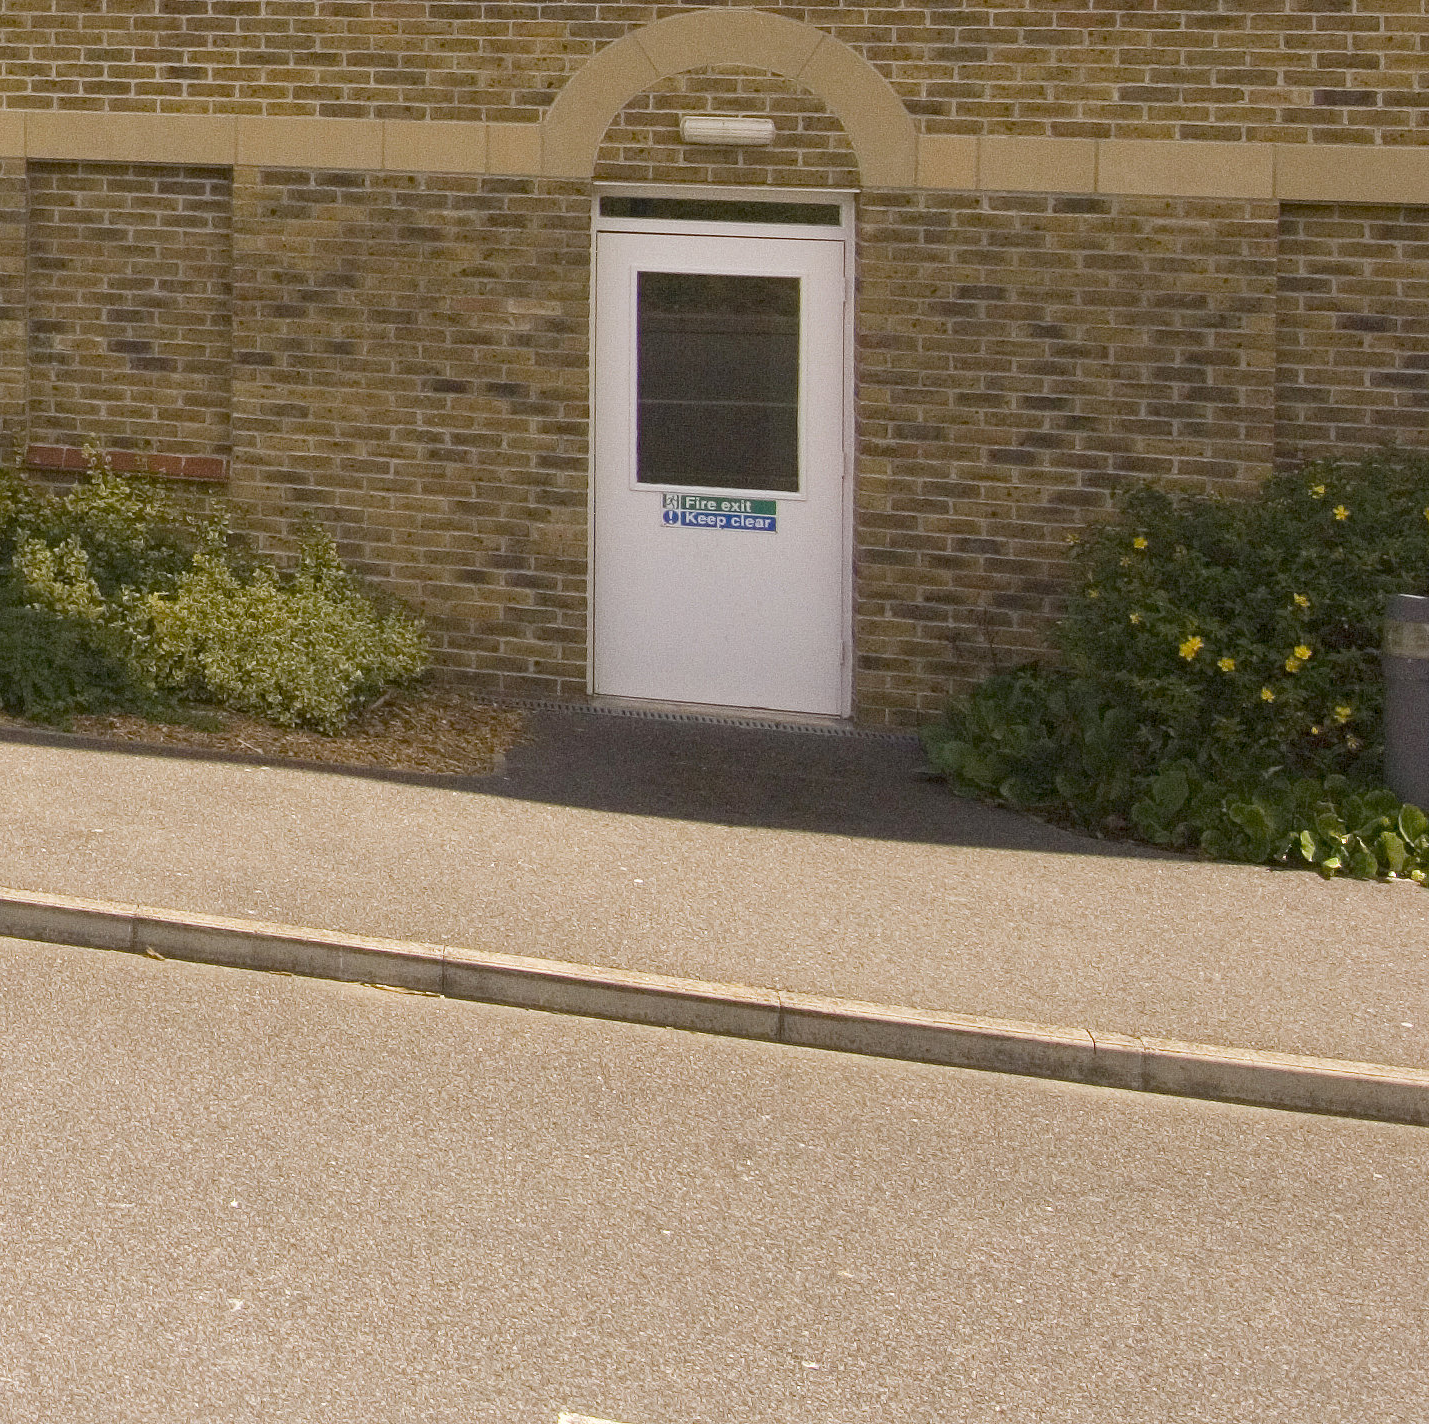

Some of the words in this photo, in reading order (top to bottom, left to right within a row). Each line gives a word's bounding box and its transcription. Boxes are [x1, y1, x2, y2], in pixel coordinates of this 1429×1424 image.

[685, 496, 717, 511] Fire
[721, 499, 752, 512] exit
[685, 511, 726, 529] Keep
[730, 514, 772, 529] clear
